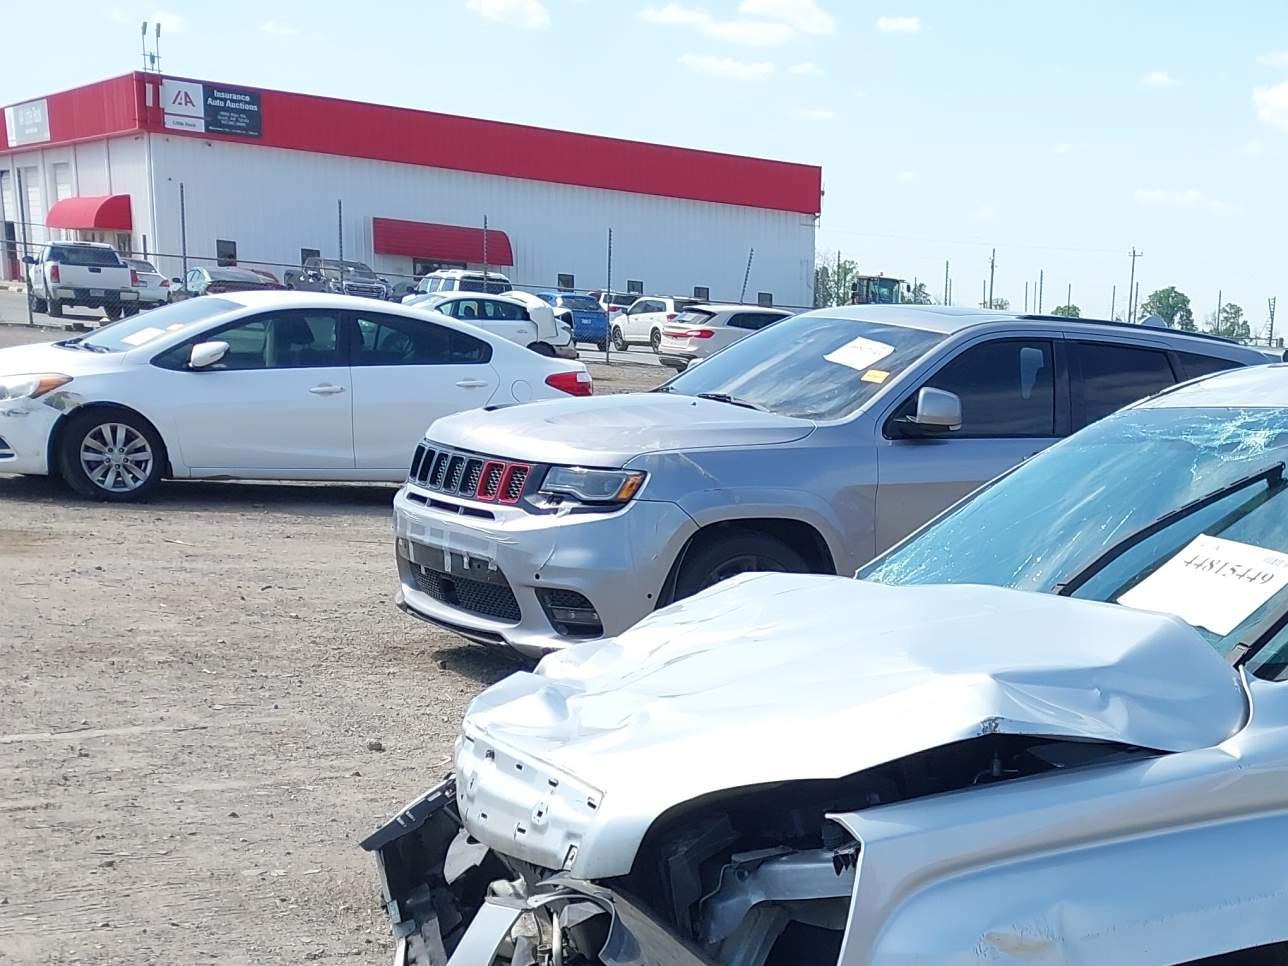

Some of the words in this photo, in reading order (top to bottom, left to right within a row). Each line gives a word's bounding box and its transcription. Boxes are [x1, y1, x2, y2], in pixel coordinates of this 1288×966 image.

[214, 90, 250, 102] Insurance
[207, 98, 224, 107] Auto
[226, 100, 258, 111] Auctions
[1183, 554, 1275, 584] 44815449
